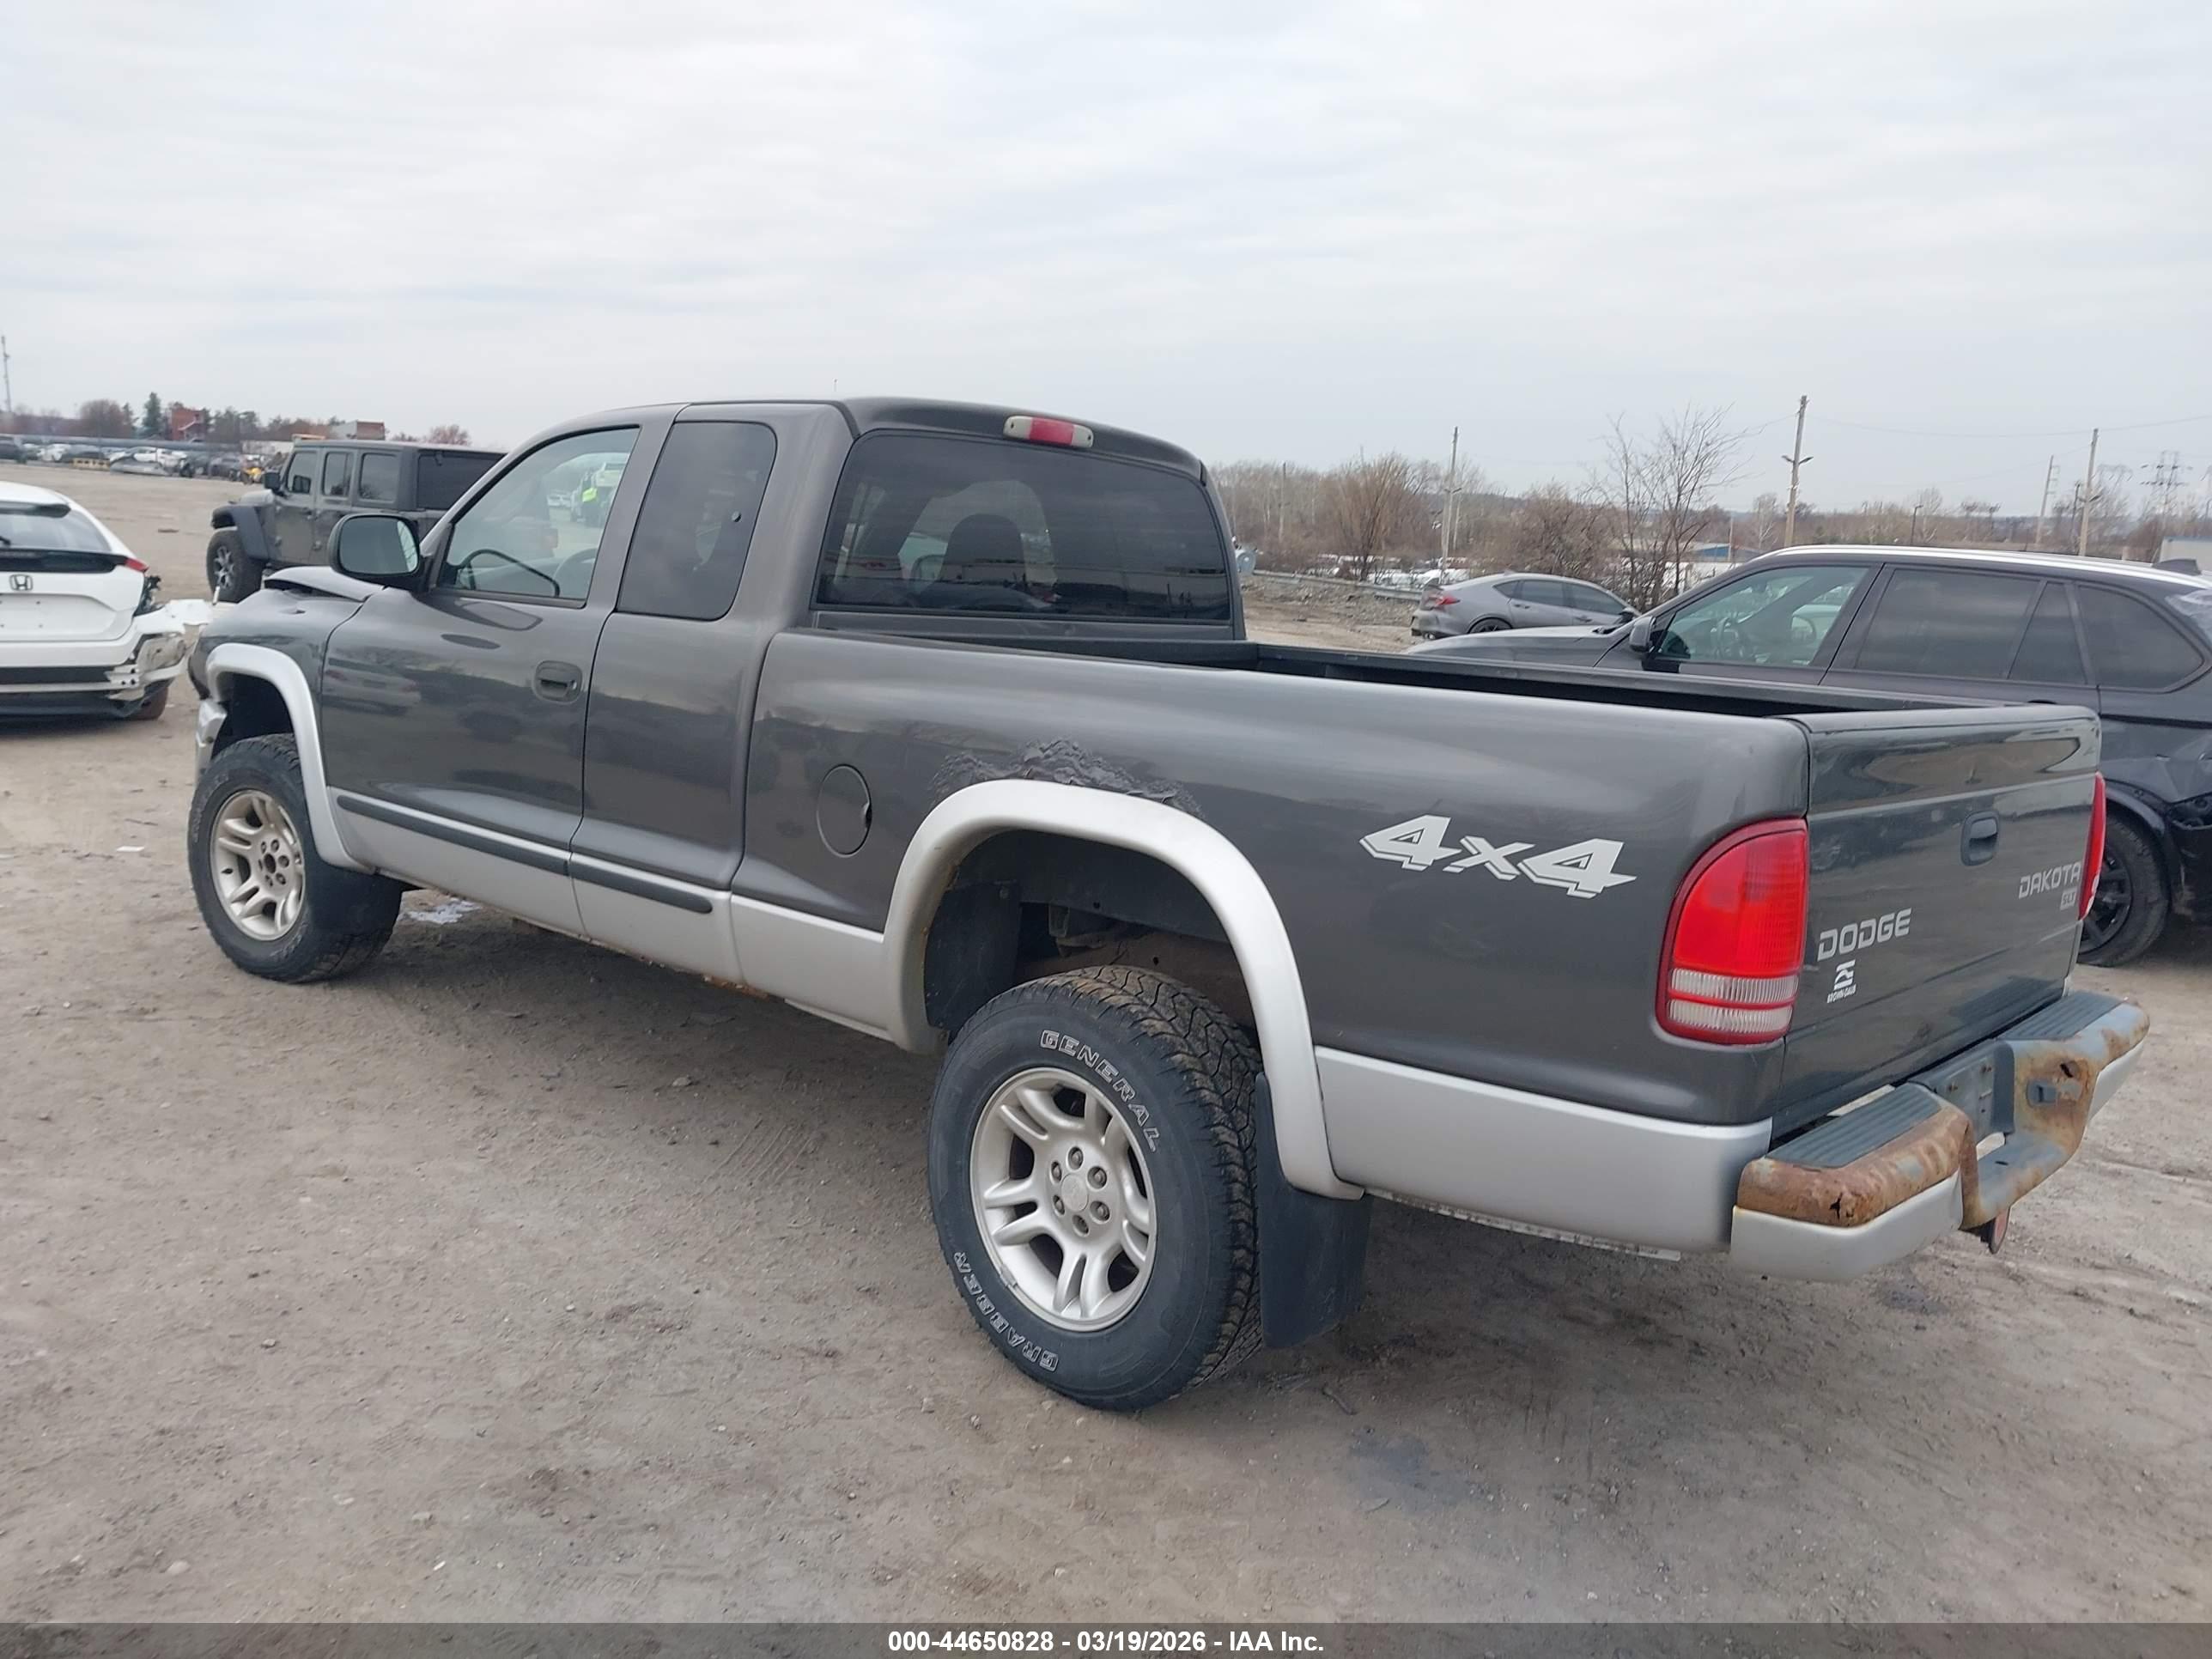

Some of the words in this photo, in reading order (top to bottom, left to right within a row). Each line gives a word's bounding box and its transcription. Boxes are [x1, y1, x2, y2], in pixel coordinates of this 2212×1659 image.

[2018, 861, 2081, 899] DAKOTA
[1817, 908, 1912, 962] DODGE
[1040, 1030, 1160, 1152] GENERAL
[954, 1252, 1059, 1371] GRABBER
